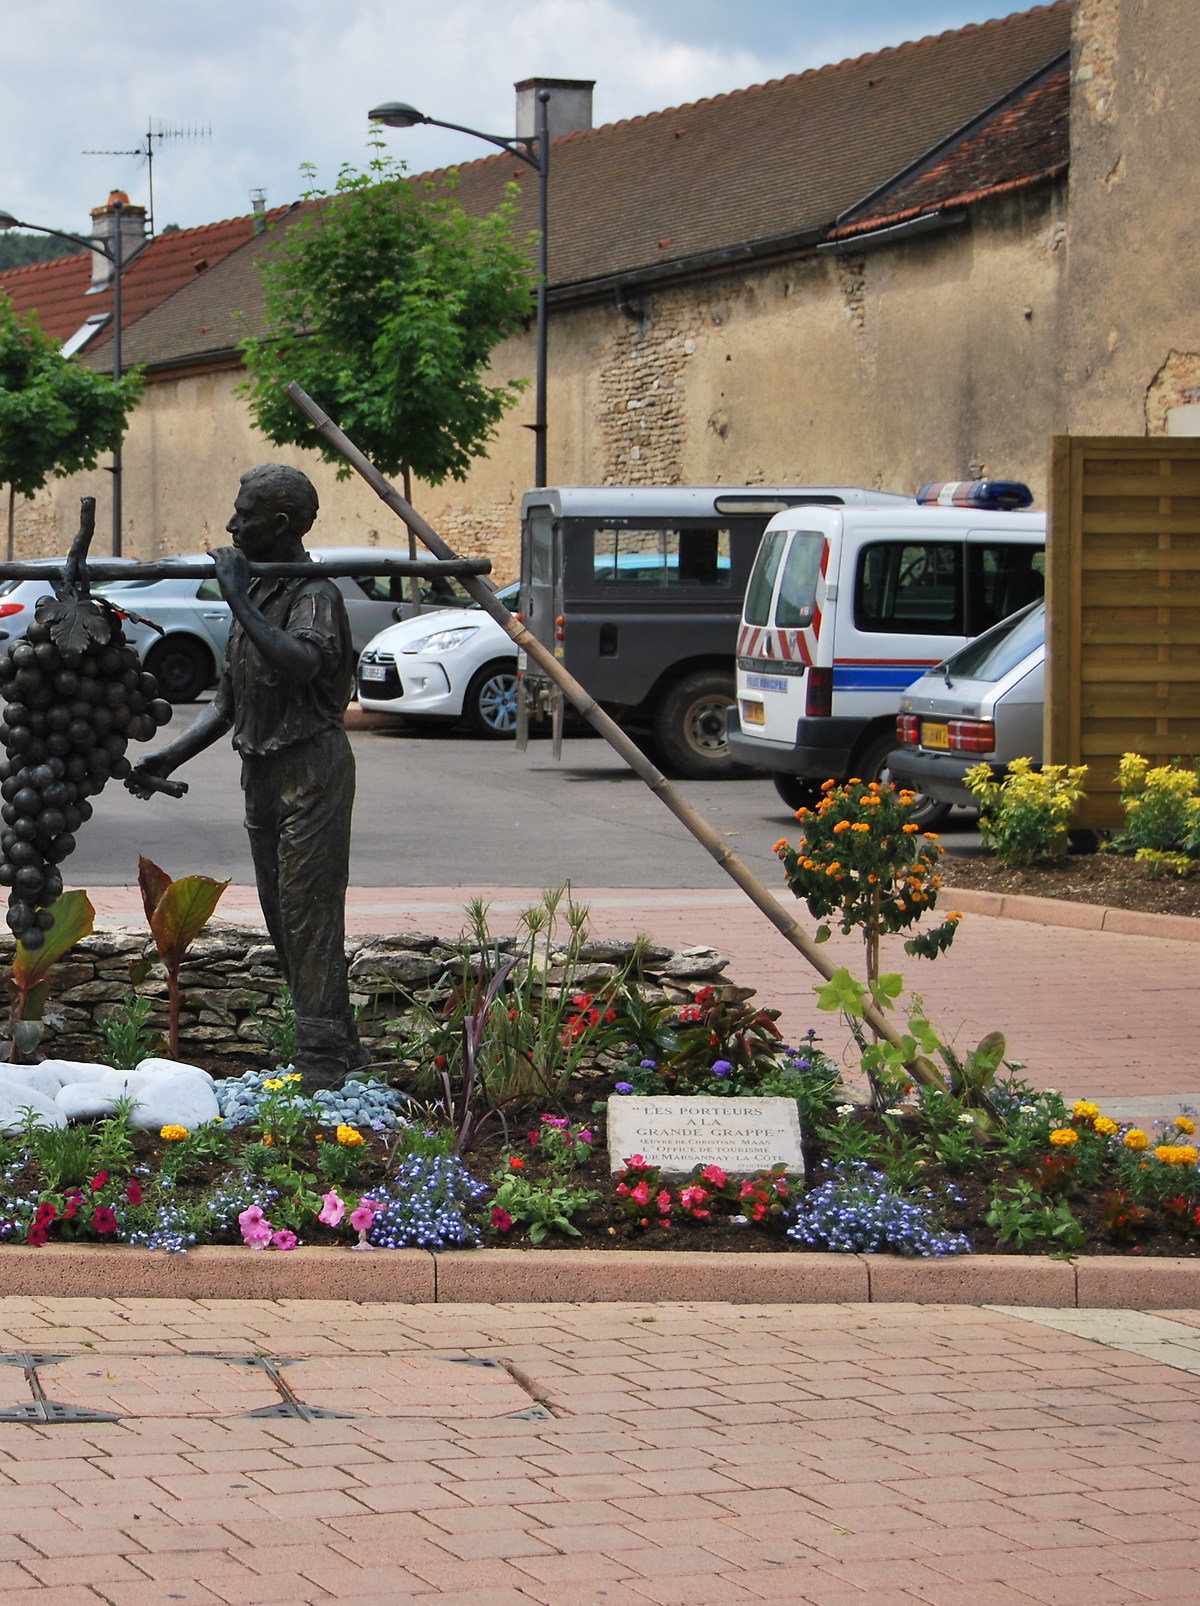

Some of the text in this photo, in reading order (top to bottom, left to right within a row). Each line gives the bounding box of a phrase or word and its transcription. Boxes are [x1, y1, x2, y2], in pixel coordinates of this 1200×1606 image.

[680, 1107, 763, 1116] PORTEURS
[701, 1118, 722, 1126] LA
[636, 1128, 703, 1136] GRANDE
